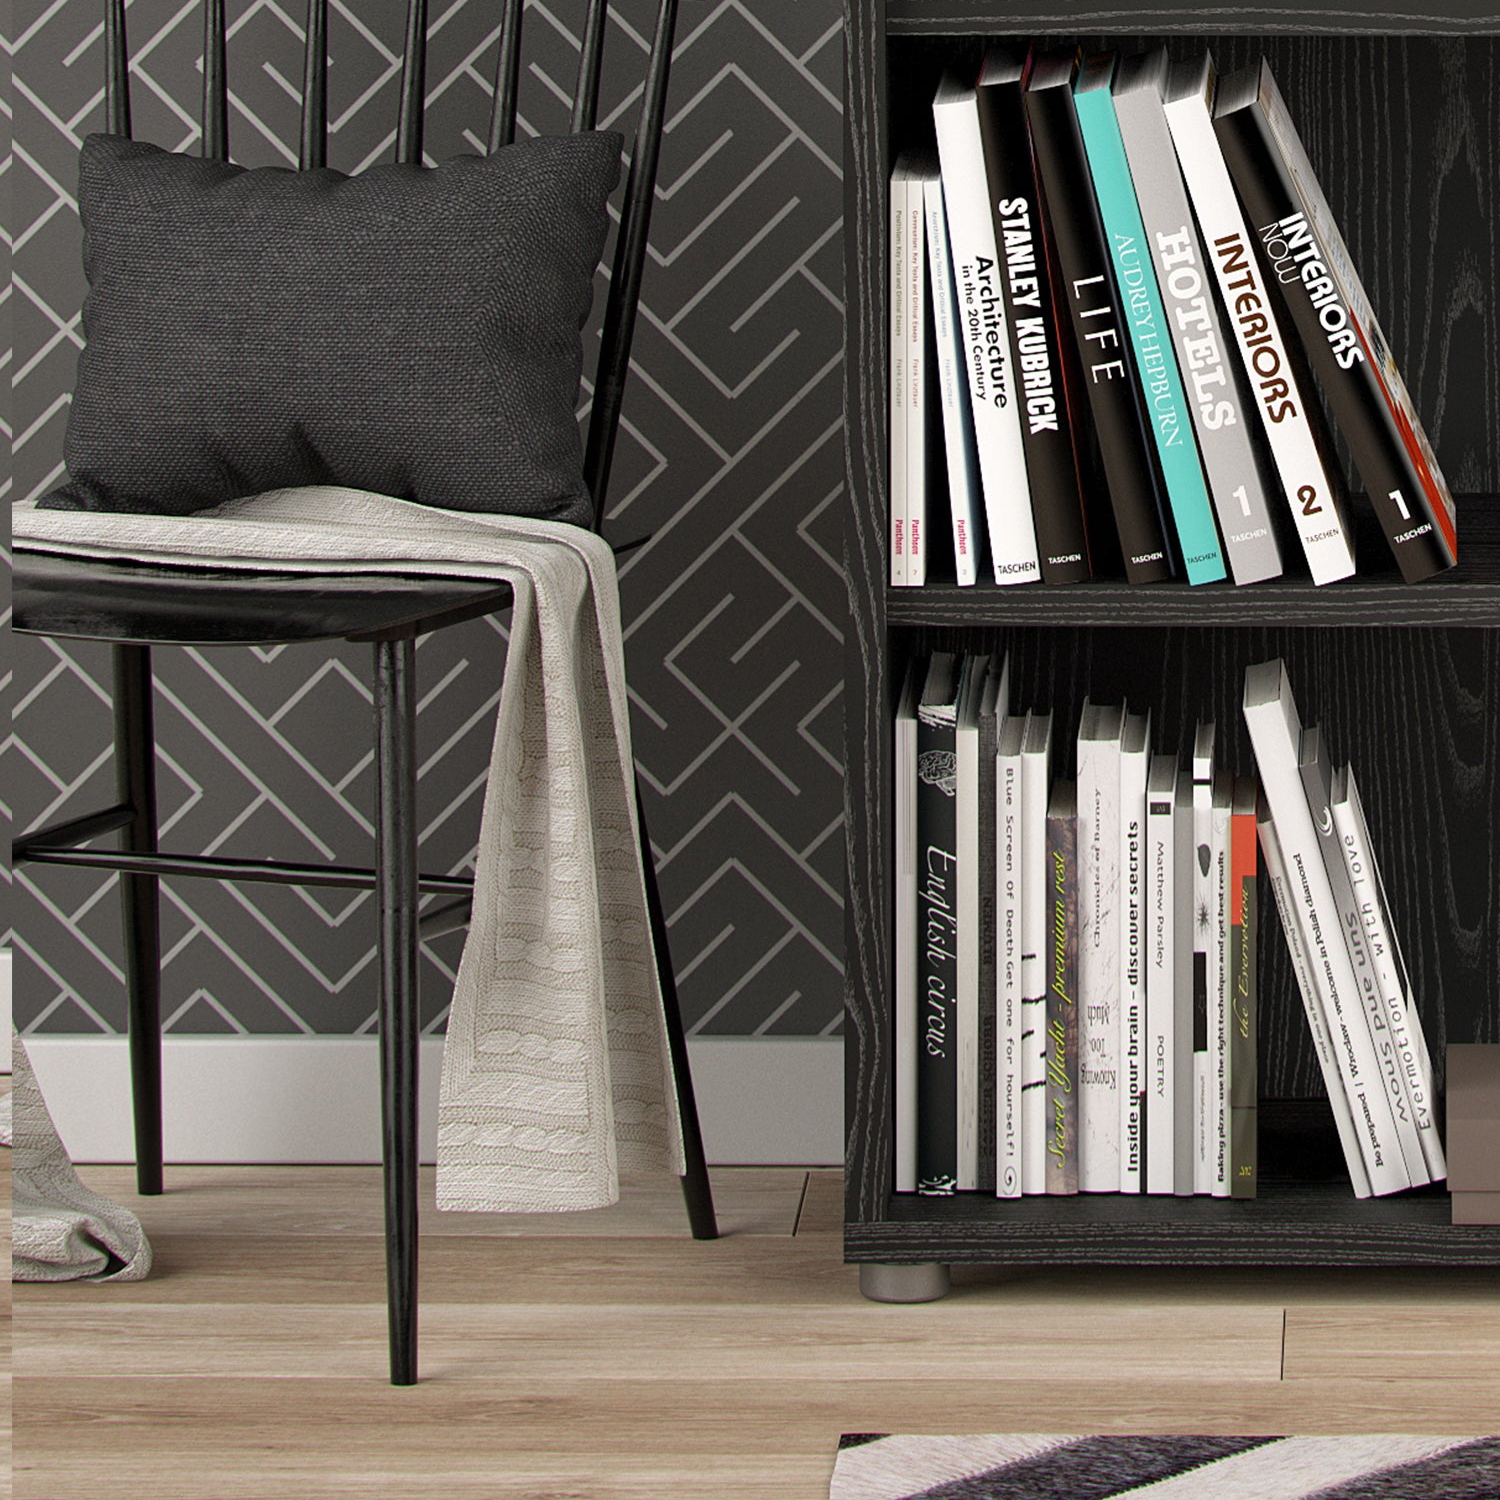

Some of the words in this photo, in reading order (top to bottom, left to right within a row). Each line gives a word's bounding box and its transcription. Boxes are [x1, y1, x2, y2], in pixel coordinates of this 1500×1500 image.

[962, 265, 971, 278] in
[999, 197, 1042, 309] STANLEY
[1258, 222, 1301, 284] NOW
[964, 281, 974, 305] the
[1278, 212, 1365, 370] INTERIORS
[968, 309, 982, 341] 20th
[976, 256, 1008, 409] Architecture
[1073, 275, 1125, 384] LIFE
[1114, 233, 1155, 329] AUDREY
[1139, 331, 1183, 448] HEPBURN
[1156, 225, 1237, 431] HOTELS
[1214, 232, 1297, 424] INTERIORS
[973, 345, 987, 401] Century
[1015, 316, 1059, 435] KUBRICK
[1233, 485, 1251, 517] 1
[1297, 485, 1323, 516] 2
[1388, 489, 1411, 520] 1
[1131, 551, 1163, 565] TASCHEN
[1187, 552, 1217, 565] TASCHEN
[1230, 528, 1267, 543] TASCHEN
[1305, 528, 1339, 544] TASCHEN
[1394, 523, 1432, 544] TASCHEN
[998, 561, 1036, 575] TASCHEN
[1048, 553, 1082, 565] TASCHEN
[1006, 768, 1014, 805] Blue
[1006, 815, 1014, 872] Screen
[1127, 821, 1138, 895] secrets
[1344, 834, 1365, 887] love
[1006, 881, 1014, 899] Of
[1053, 850, 1066, 895] rest
[1156, 841, 1164, 912] Matthew
[1292, 852, 1313, 908] diamond
[918, 845, 957, 968] English
[983, 896, 993, 965] BLUMEN
[1218, 920, 1226, 939] get
[1309, 908, 1324, 946] Polish
[1361, 902, 1384, 957] with
[1006, 909, 1014, 957] Death
[1052, 899, 1072, 1004] premium
[1127, 898, 1138, 986] discover
[1156, 916, 1164, 969] Parsley
[1320, 946, 1328, 958] in
[1217, 966, 1225, 1028] technique
[1300, 965, 1315, 1012] everything
[1323, 960, 1342, 1015] welcome
[926, 975, 957, 1059] circus
[1087, 1002, 1110, 1027] Much
[1127, 1005, 1138, 1057] brain
[1232, 998, 1249, 1039] the
[1312, 1012, 1318, 1022] in
[1315, 1023, 1323, 1039] one
[1345, 912, 1366, 967] sun
[1363, 977, 1386, 1031] and
[1380, 1041, 1408, 1123] snow
[1006, 1036, 1014, 1065] for
[1048, 1019, 1072, 1093] Yacht
[1156, 1035, 1164, 1098] POETRY
[1217, 1030, 1226, 1059] right
[1318, 1040, 1329, 1064] place
[1387, 997, 1431, 1130] Evermotion
[1081, 1063, 1116, 1090] Knowing
[1129, 1059, 1141, 1106] your
[1006, 1074, 1014, 1156] hourself!
[1048, 1098, 1066, 1169] Secret
[1217, 1107, 1225, 1138] pizza
[1357, 1092, 1381, 1150] prepared
[1127, 1112, 1138, 1173] Inside
[1217, 1140, 1225, 1182] Baking
[1375, 1150, 1384, 1167] Be
